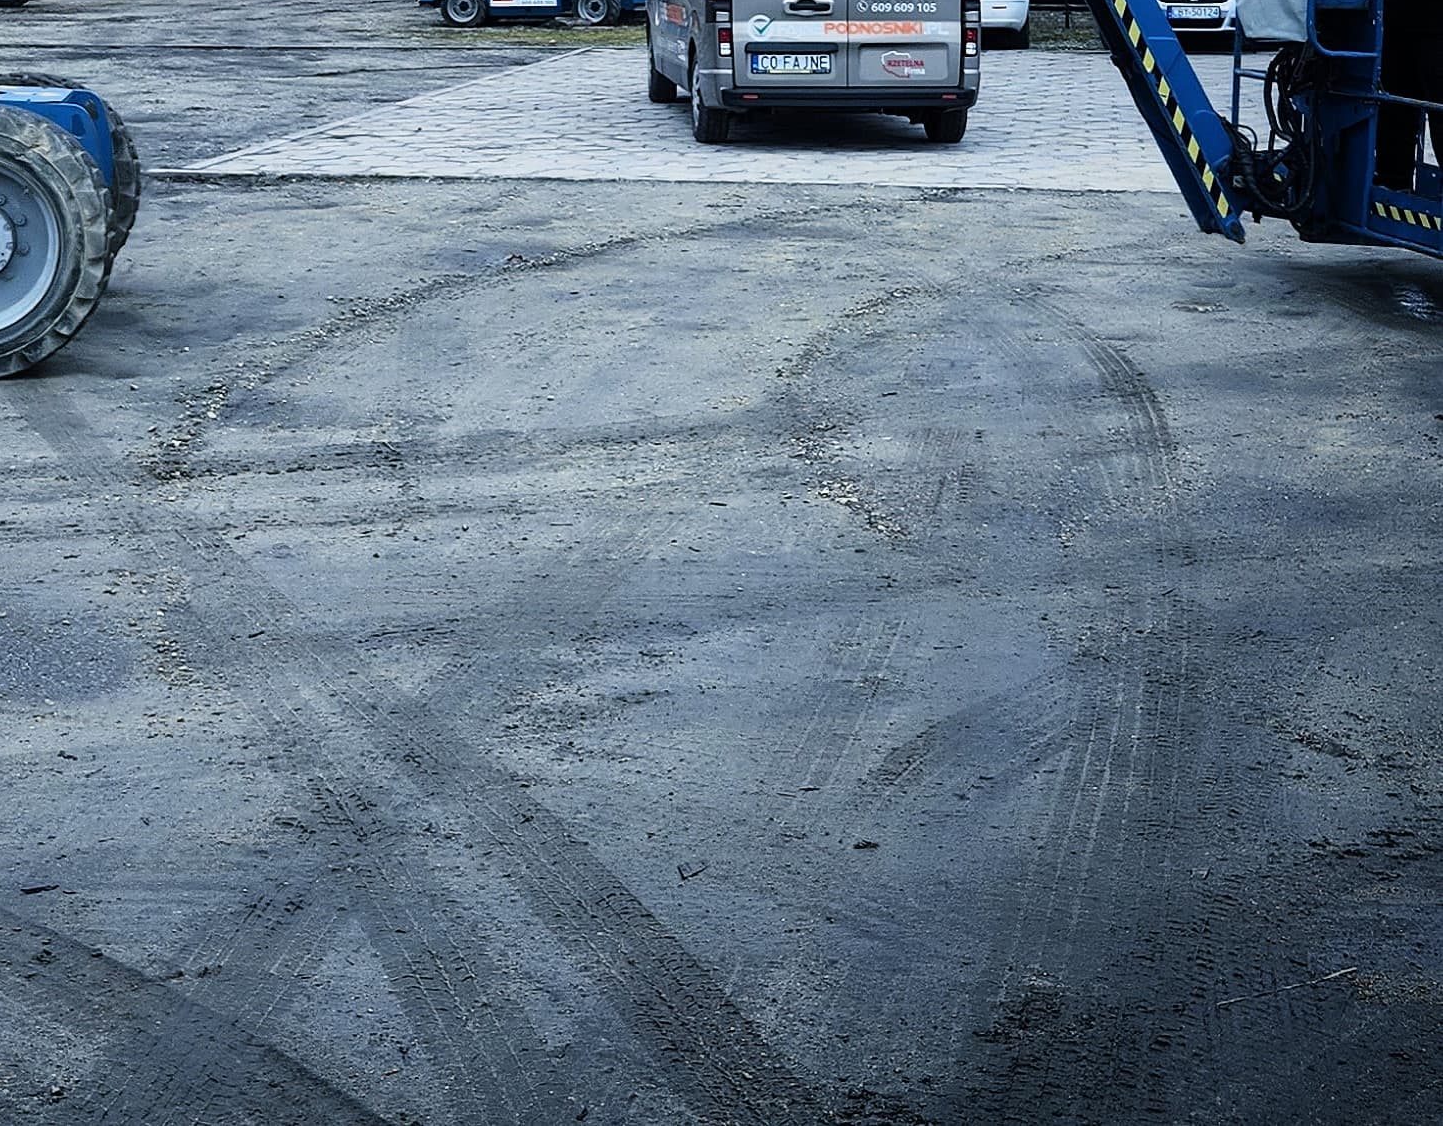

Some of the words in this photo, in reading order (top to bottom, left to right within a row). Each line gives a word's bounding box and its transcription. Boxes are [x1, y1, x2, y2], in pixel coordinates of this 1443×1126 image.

[871, 2, 892, 12] 609
[893, 2, 914, 12] 609
[917, 2, 938, 12] 105
[784, 55, 828, 69] FAJNE
